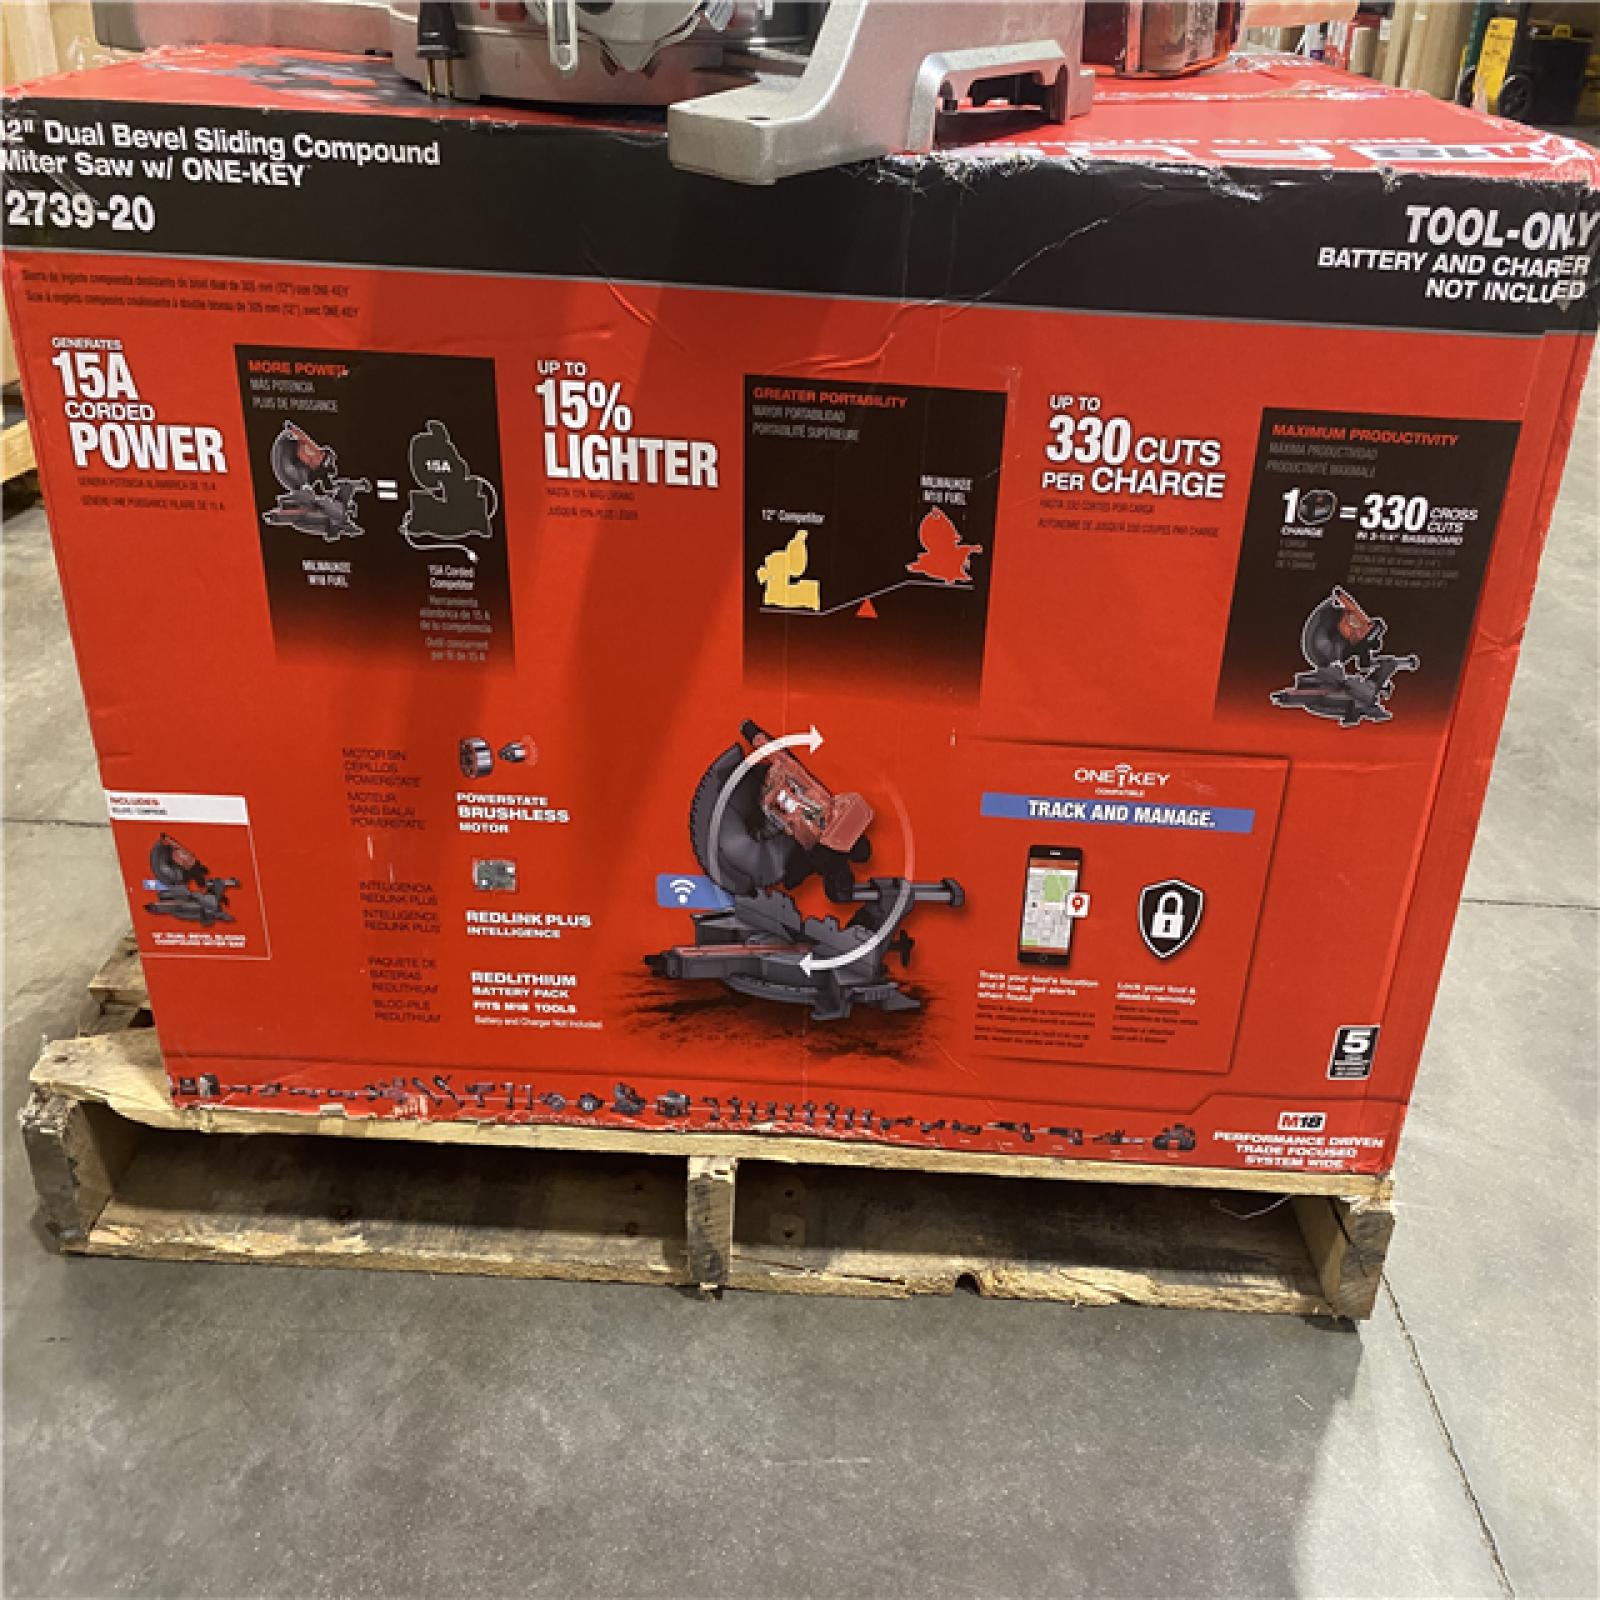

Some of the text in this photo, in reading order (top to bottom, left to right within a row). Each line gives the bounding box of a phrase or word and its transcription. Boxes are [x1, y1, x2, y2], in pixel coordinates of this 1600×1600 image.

[44, 120, 106, 146] Dual
[112, 122, 188, 150] Bevel
[194, 127, 284, 162] Sliding
[294, 134, 441, 167] Compound
[75, 151, 133, 177] Saw
[141, 156, 173, 180] w/
[182, 156, 305, 187] ONE-KEY
[4, 189, 156, 232] 2739-20
[1405, 205, 1600, 251] TOOL-ONY
[1317, 246, 1591, 279] BATTERY AND CHARER
[1425, 277, 1586, 304] NOT INCLUED
[52, 351, 140, 401] 15A
[249, 360, 291, 376] MORE
[537, 360, 586, 376] UP TO
[753, 387, 816, 403] GREATER
[1050, 395, 1101, 412] UP TO
[65, 401, 156, 421] CORDED
[535, 378, 633, 432] 15%
[1045, 414, 1221, 466] 330 CUTS
[1272, 423, 1460, 446] MAXIMUM PRODUCTIVITY
[69, 421, 228, 474] POWER
[543, 432, 719, 488] LIGHTER
[1042, 466, 1226, 499] PER CHARGE
[1282, 487, 1429, 532] 1 330
[1429, 507, 1478, 521] CROSS
[1426, 521, 1464, 534] CUTS
[456, 792, 549, 806] POWERSTATE
[457, 806, 570, 824] BRUSHLESS
[1027, 799, 1216, 828] TRACK AND MANAGE.
[459, 822, 509, 833] MOTOR
[465, 910, 592, 928] REDLINK PLUS
[466, 926, 561, 939] INTELLIGENCE
[471, 971, 577, 987] REDLITHIUM
[472, 986, 569, 999] BATTERY PACK
[534, 1003, 577, 1014] TOOLS
[1342, 1029, 1371, 1054] 5
[1281, 1114, 1323, 1129] M18
[1214, 1131, 1385, 1148] PERFORMANCE DRIVEN
[1236, 1144, 1284, 1155] TRADE
